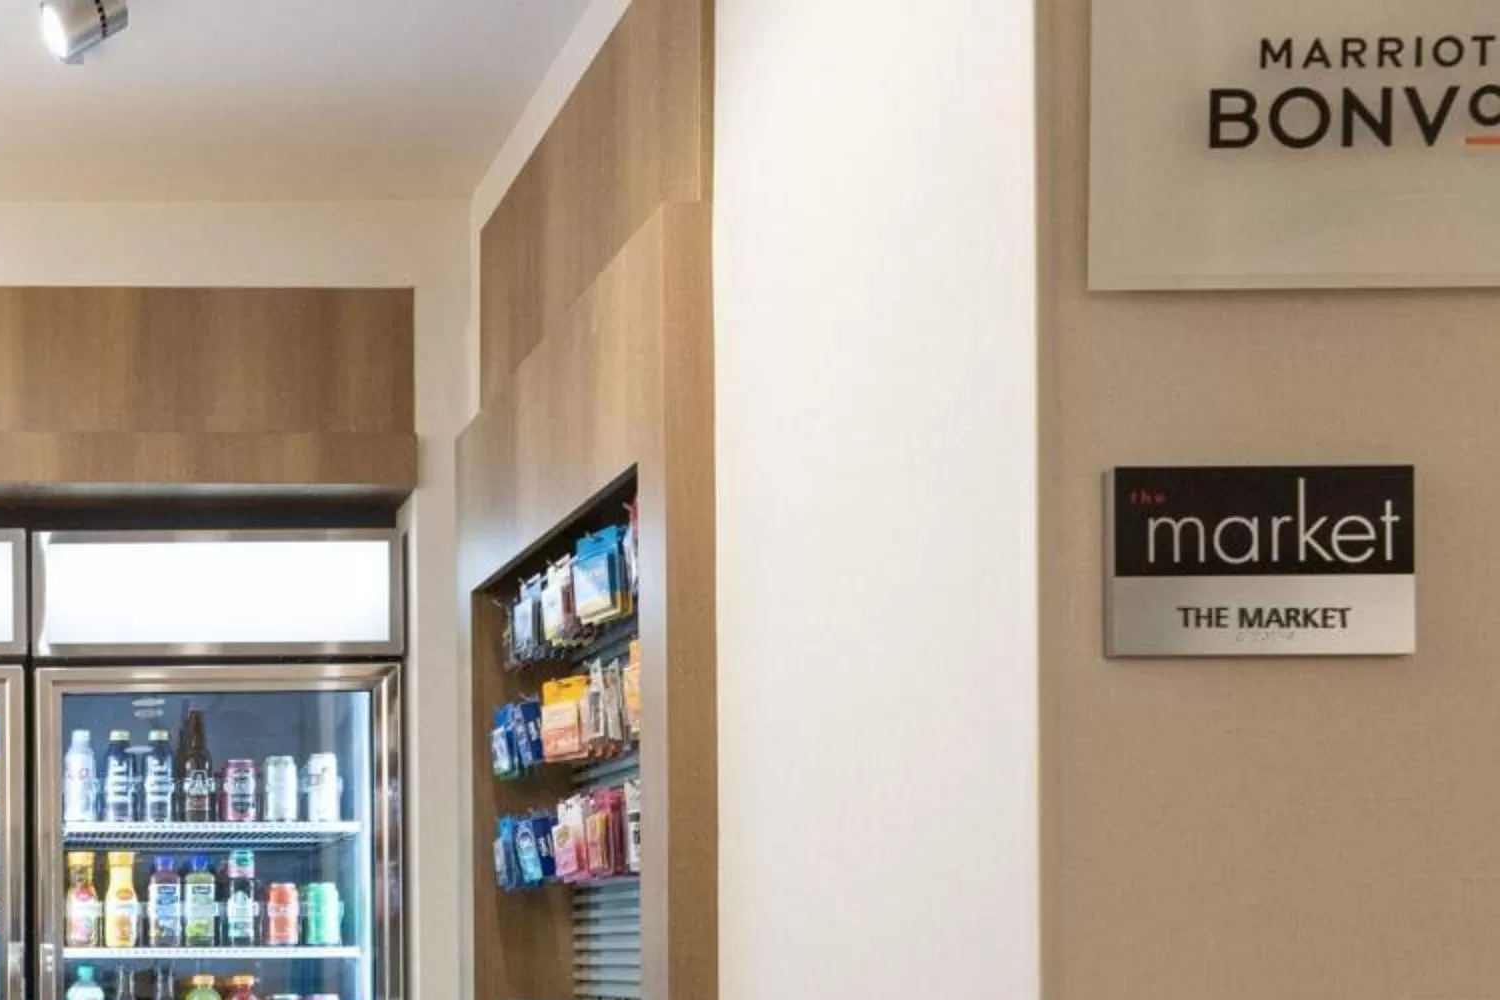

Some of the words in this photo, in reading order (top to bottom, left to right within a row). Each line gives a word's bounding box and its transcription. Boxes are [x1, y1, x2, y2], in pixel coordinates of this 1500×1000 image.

[1260, 35, 1496, 69] MARRIOT
[1129, 489, 1167, 505] the
[1147, 476, 1401, 565] market
[1177, 606, 1230, 630] THE
[1237, 606, 1352, 630] MARKET
